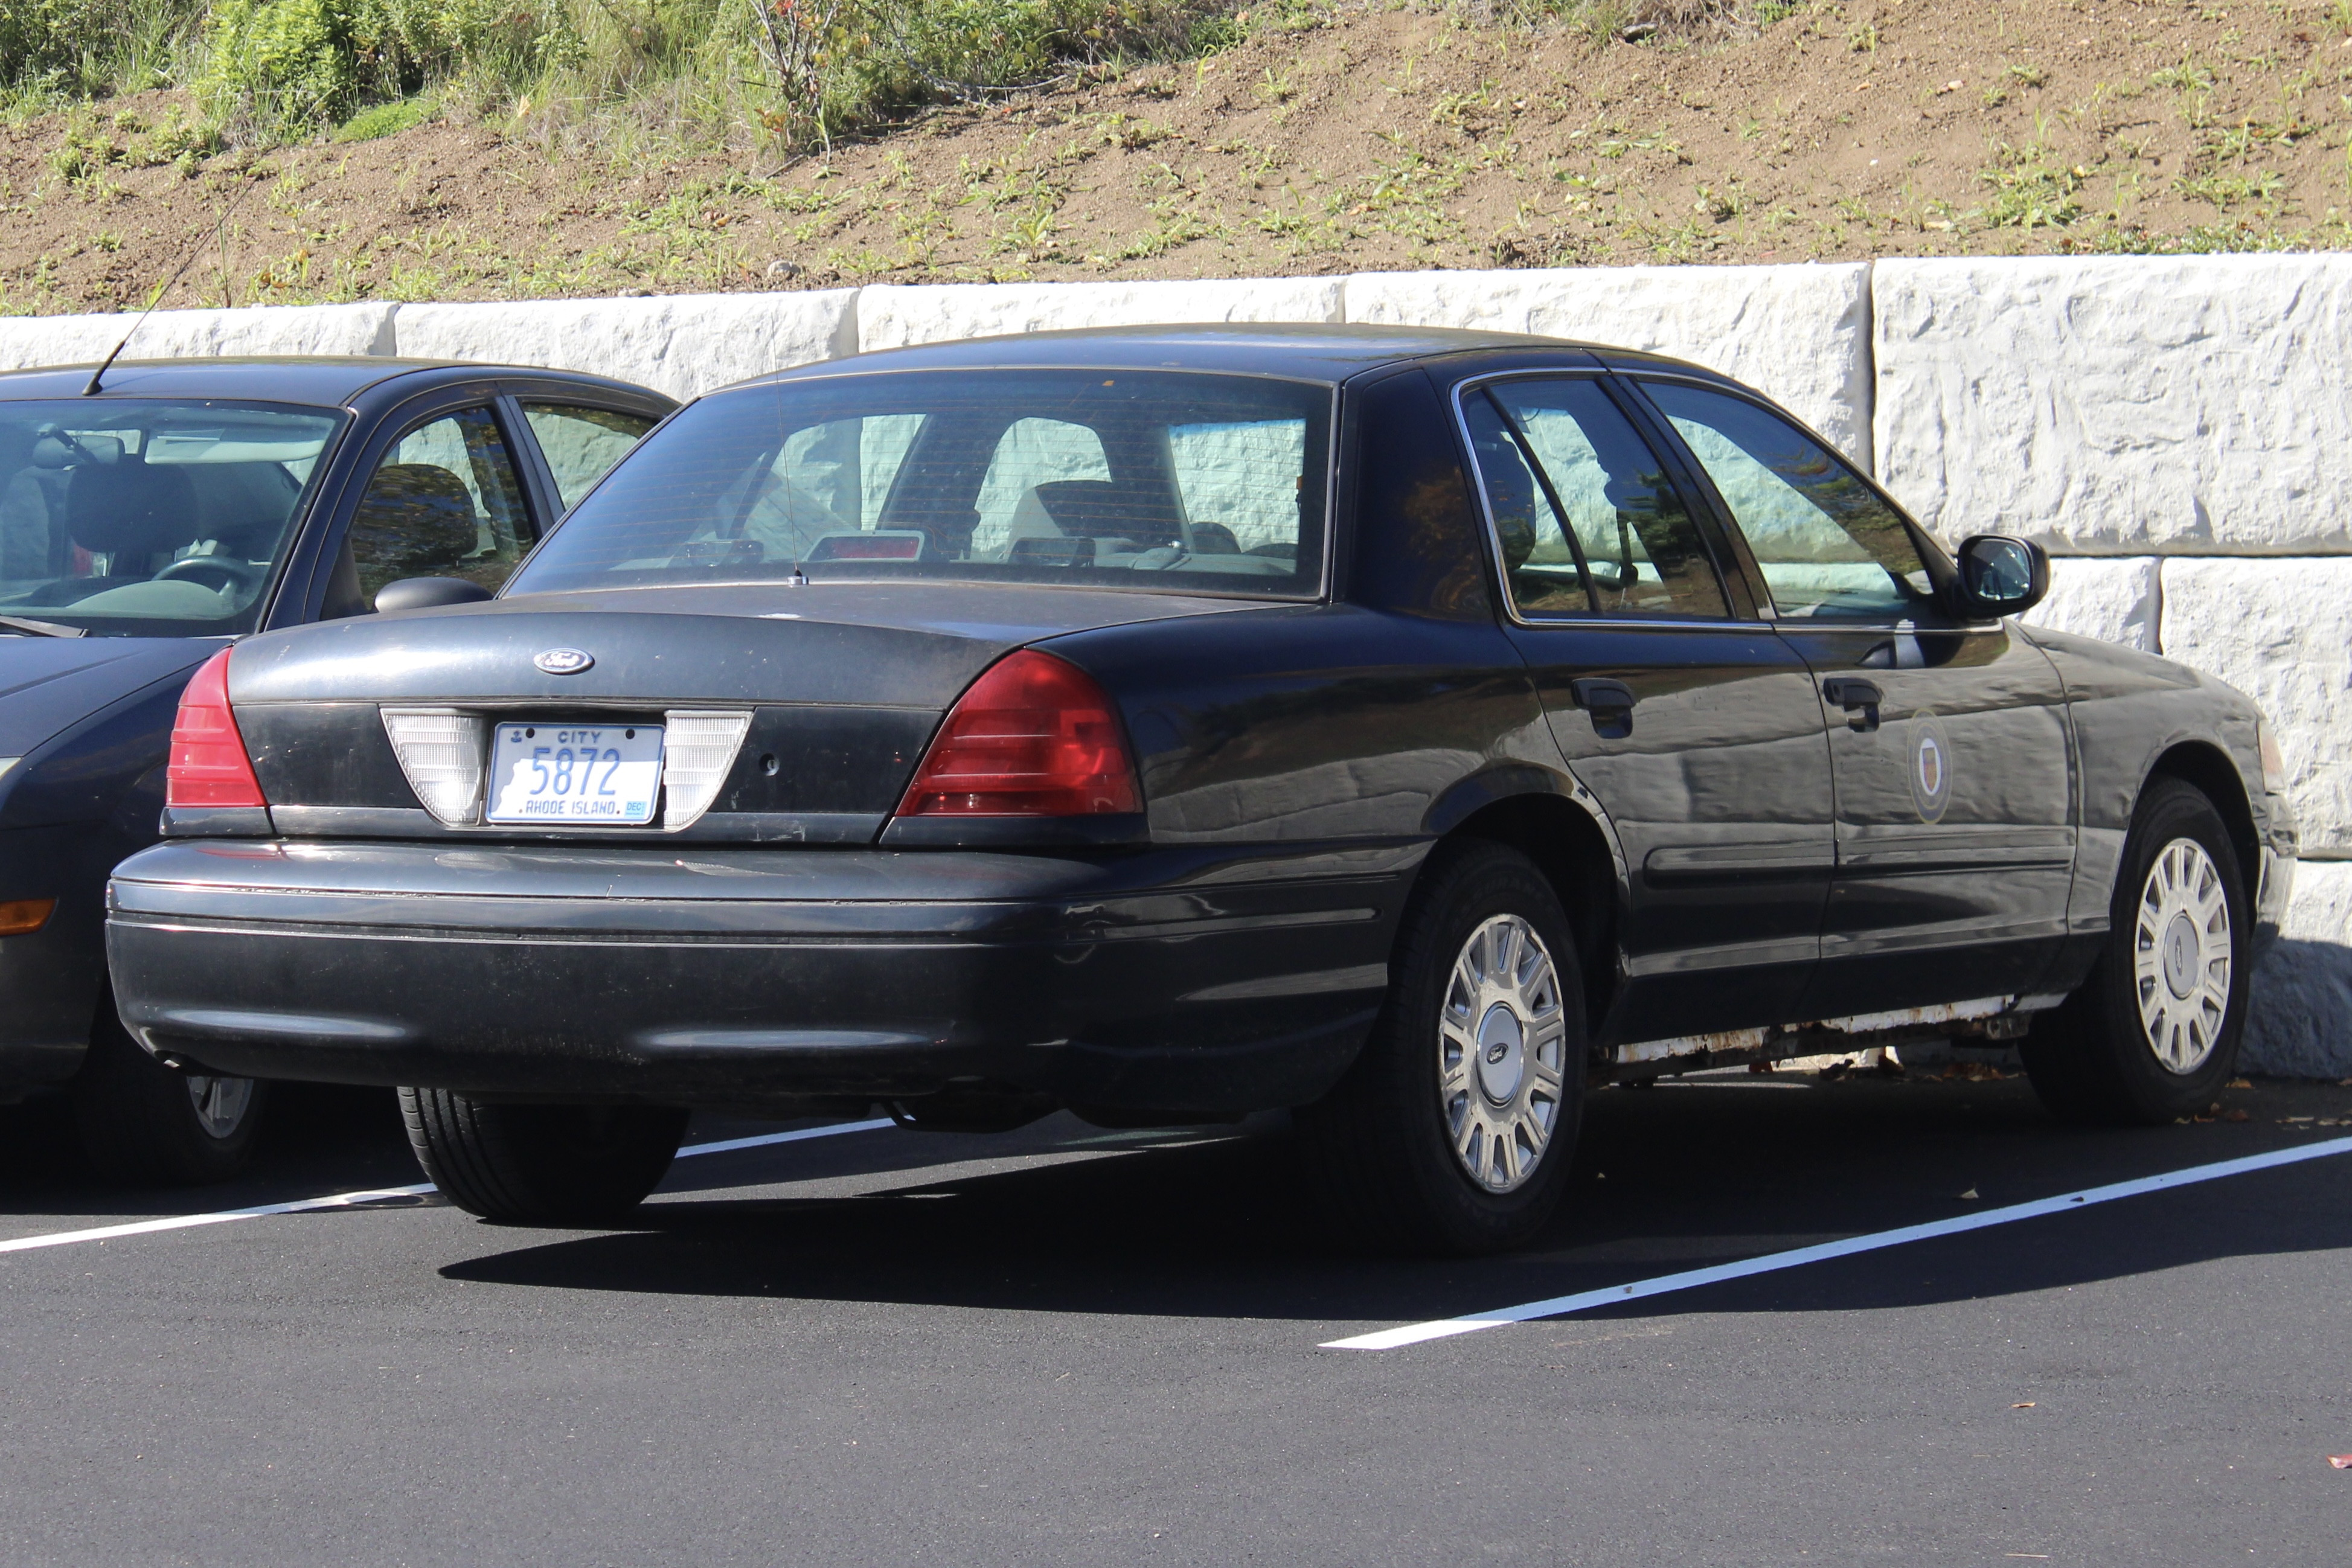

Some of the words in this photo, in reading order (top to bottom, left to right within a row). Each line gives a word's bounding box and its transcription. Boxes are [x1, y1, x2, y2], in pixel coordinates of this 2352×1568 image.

[558, 731, 602, 743] CITY
[530, 747, 620, 796] 5872
[525, 800, 566, 814] RHODE
[571, 800, 616, 814] ISLAND
[627, 802, 642, 811] DEC
[1490, 1046, 1503, 1061] Ford
